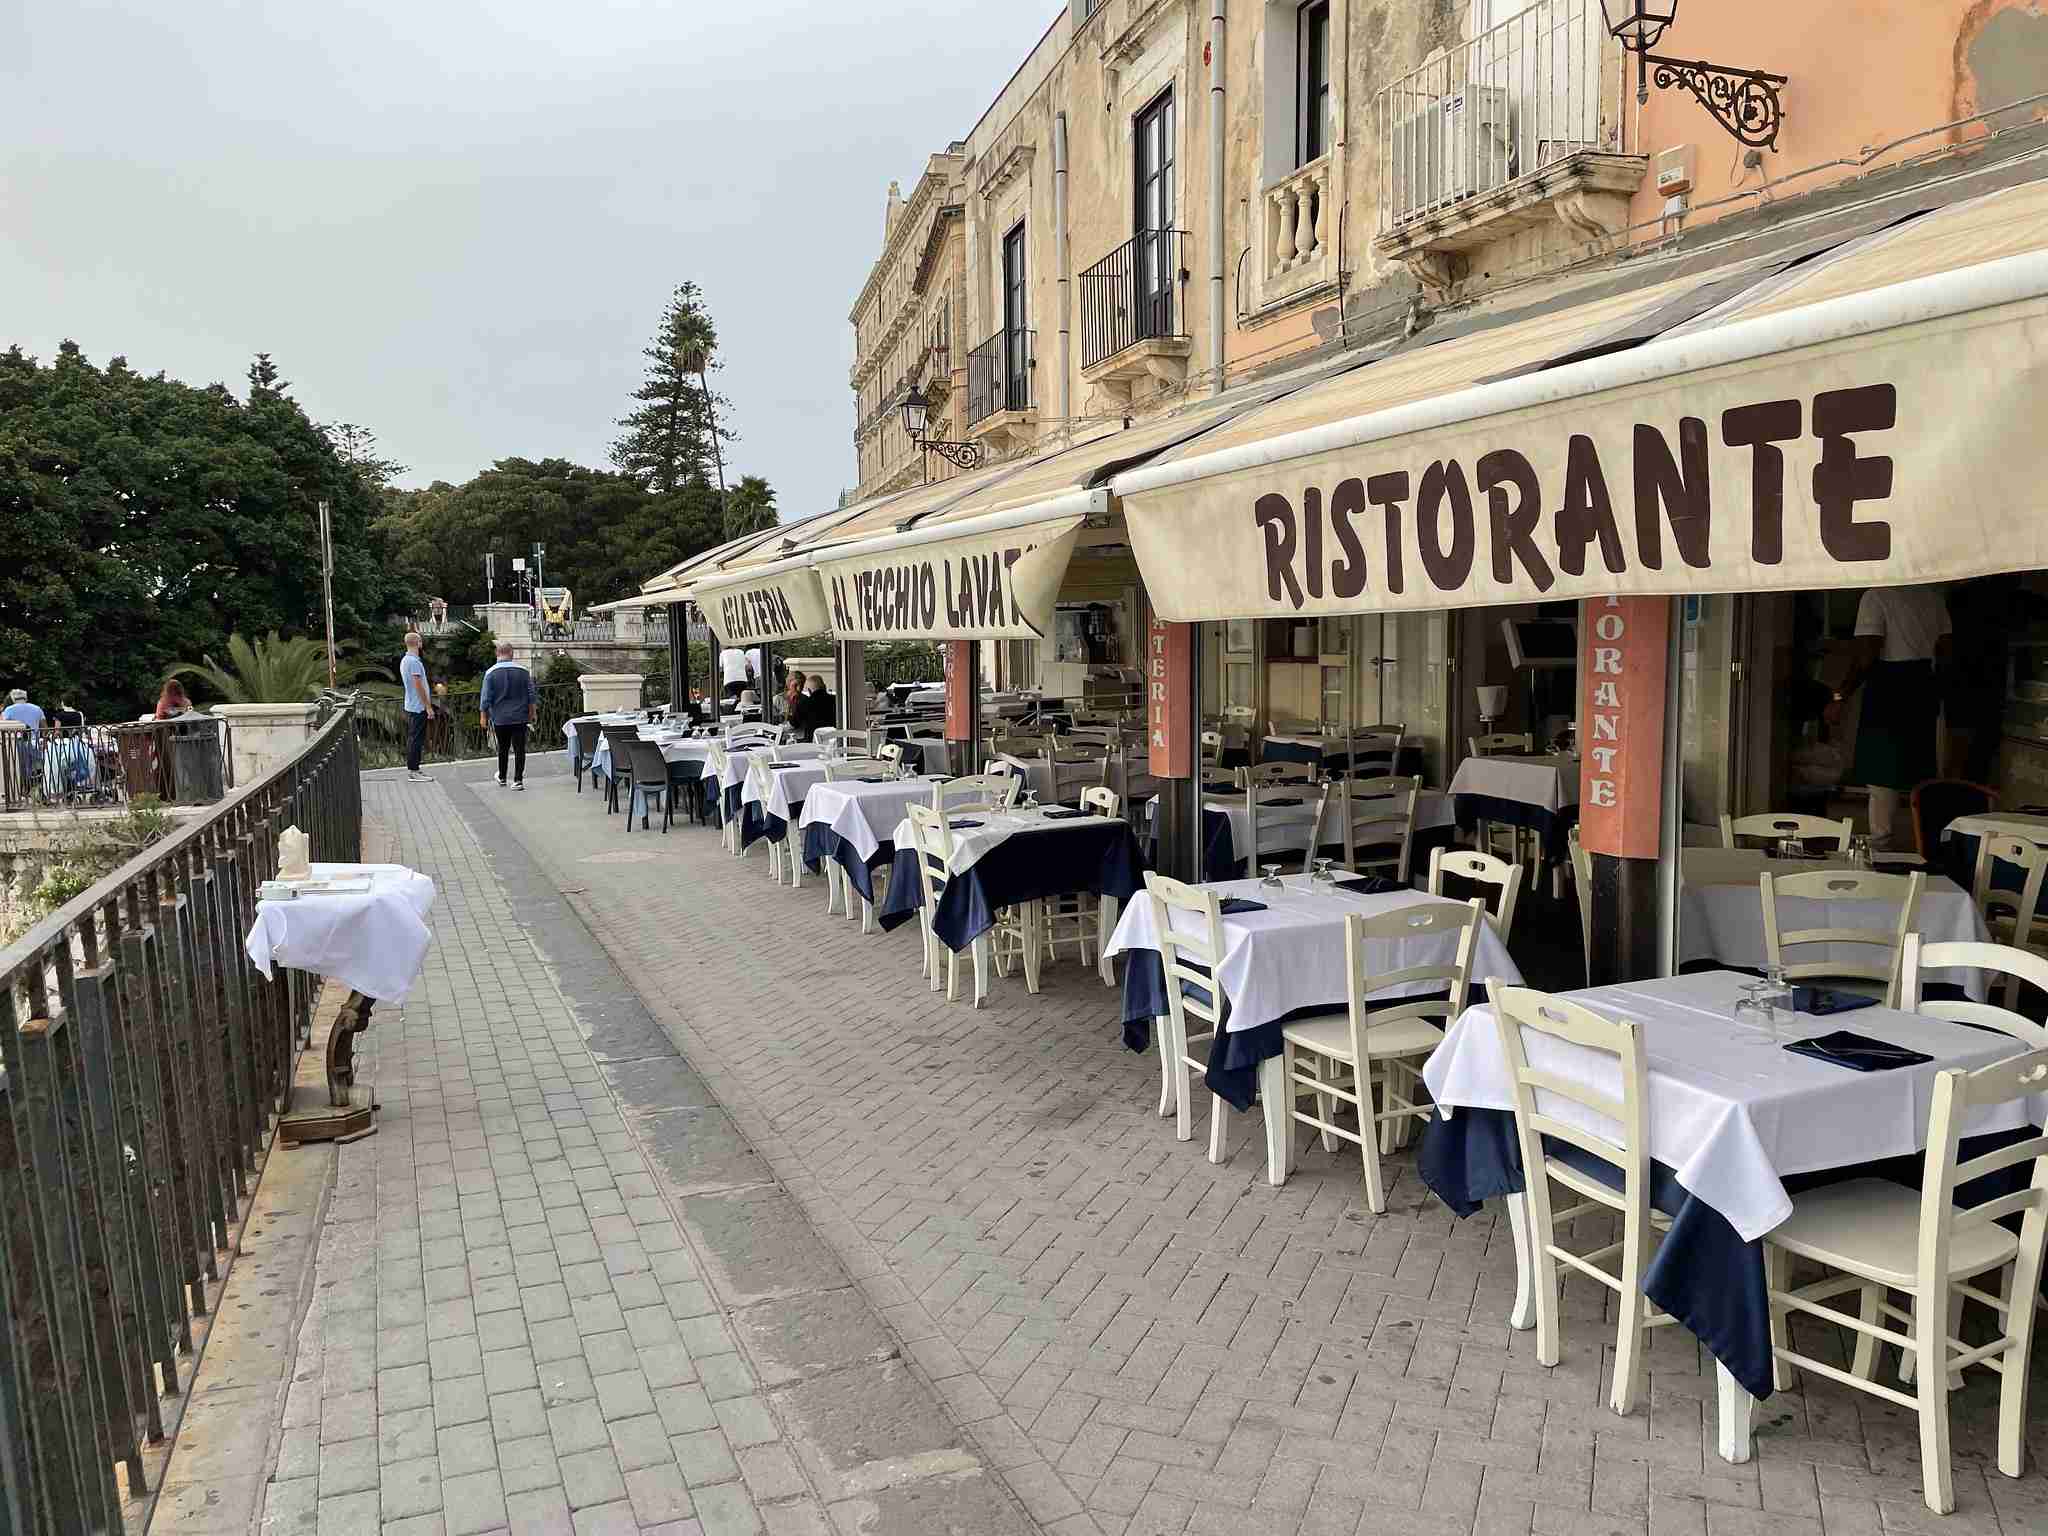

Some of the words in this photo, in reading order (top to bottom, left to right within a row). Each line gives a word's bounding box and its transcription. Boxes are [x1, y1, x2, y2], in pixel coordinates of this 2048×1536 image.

[1255, 384, 1897, 610] RISTORANTE
[722, 586, 798, 639] GELATERIA
[831, 575, 854, 631] AL
[853, 561, 936, 631] VECCHIO
